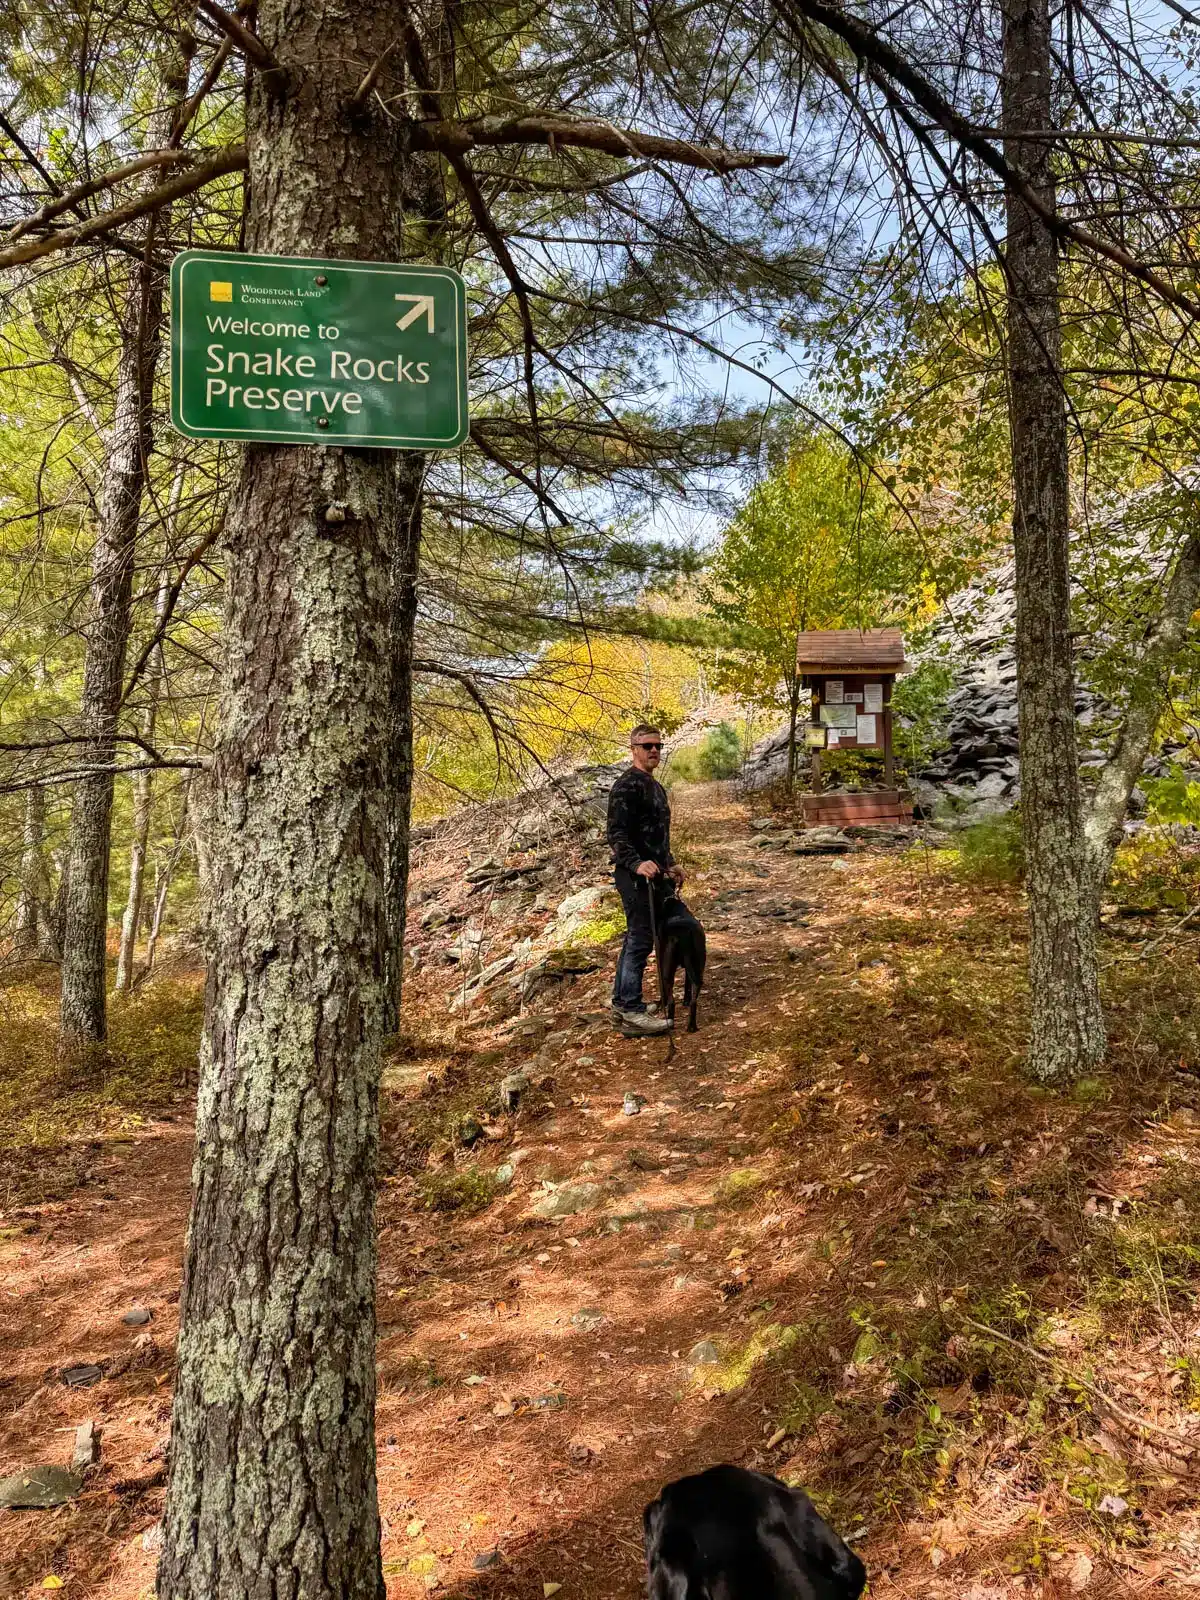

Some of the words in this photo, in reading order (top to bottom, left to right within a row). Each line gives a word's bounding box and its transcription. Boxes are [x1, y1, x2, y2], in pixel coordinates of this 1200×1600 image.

[206, 315, 311, 339] Welcome
[317, 322, 340, 340] to
[206, 343, 316, 378] Snake
[330, 350, 431, 384] Rocks
[206, 378, 363, 414] Preserve
